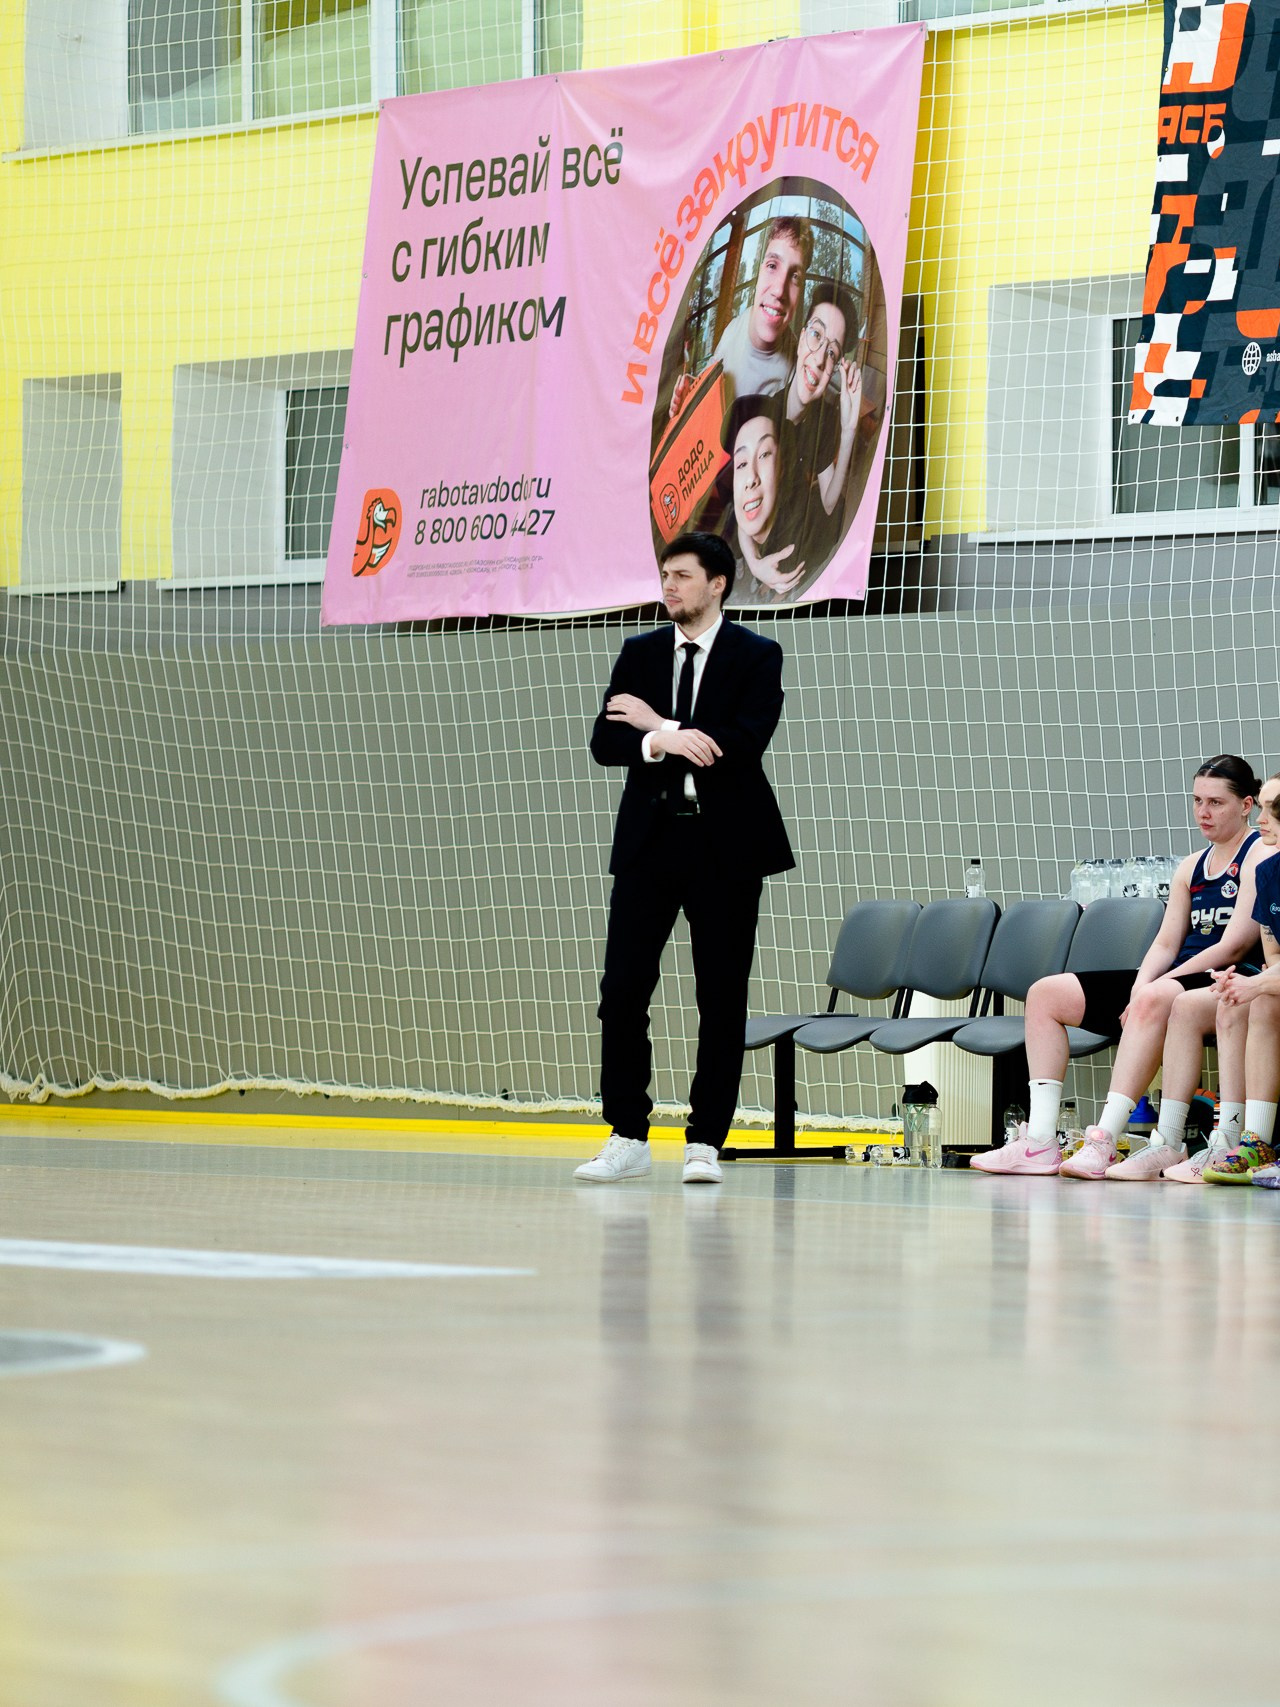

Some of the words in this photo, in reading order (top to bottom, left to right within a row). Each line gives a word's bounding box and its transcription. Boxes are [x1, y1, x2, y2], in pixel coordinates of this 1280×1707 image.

[1157, 102, 1227, 145] АСБ
[399, 133, 551, 210] Успевай
[561, 126, 624, 190] всё
[676, 102, 880, 242] закрутится
[391, 240, 412, 283] с
[420, 216, 551, 279] гибким
[632, 226, 685, 355] всё
[383, 292, 567, 369] графиком
[620, 362, 648, 405] и
[677, 439, 704, 487] ДОДО
[681, 449, 715, 501] ПИЦЦА
[419, 473, 552, 509] rabotavdodoru
[414, 519, 426, 545] 8
[429, 516, 467, 544] 800
[470, 512, 507, 541] 600
